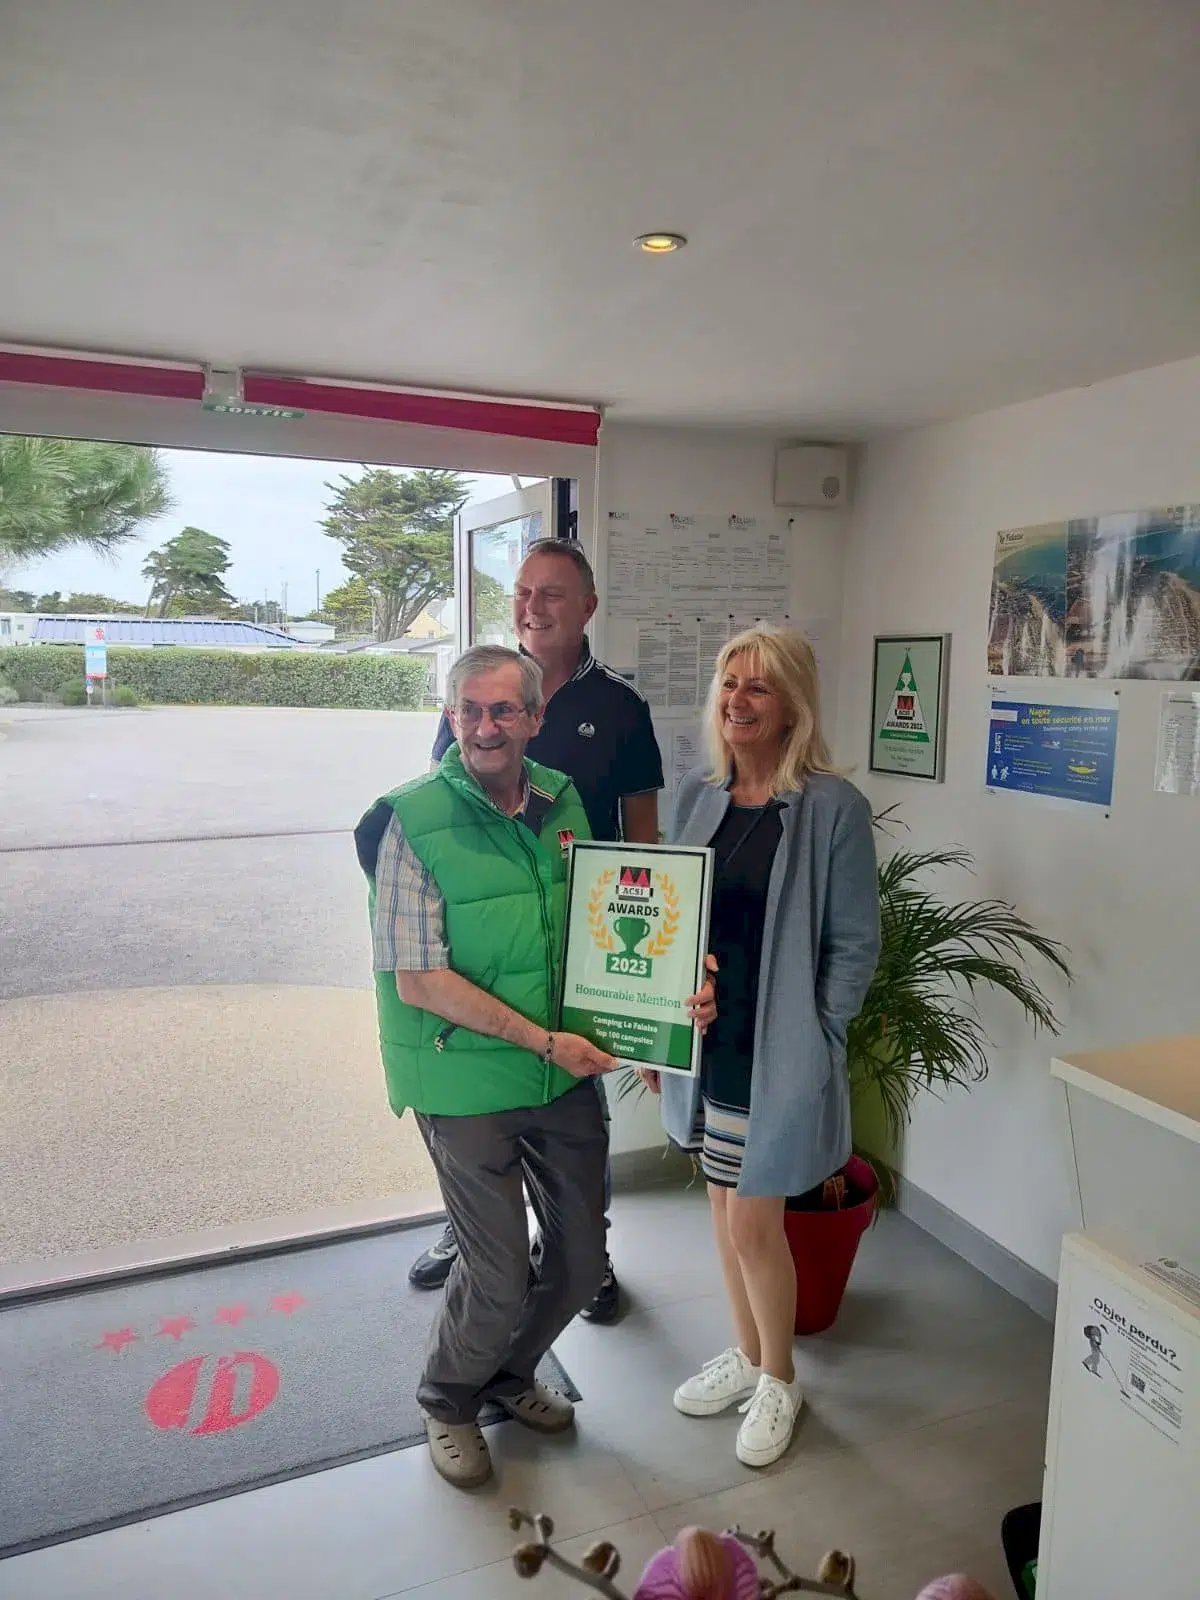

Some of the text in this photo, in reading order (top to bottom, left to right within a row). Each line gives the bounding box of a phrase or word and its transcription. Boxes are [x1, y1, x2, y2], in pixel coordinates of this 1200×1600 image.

[886, 721, 909, 729] AWARDS
[622, 887, 644, 896] ACSI
[608, 902, 660, 917] AWARDS
[610, 957, 648, 975] 2023
[575, 983, 681, 1009] Honourable Mention
[592, 1015, 658, 1033] Camping La Falaise
[596, 1028, 654, 1046] Top 100 campsites
[613, 1041, 635, 1053] France
[1094, 1298, 1126, 1327] Objet
[1129, 1324, 1177, 1361] perdu?
